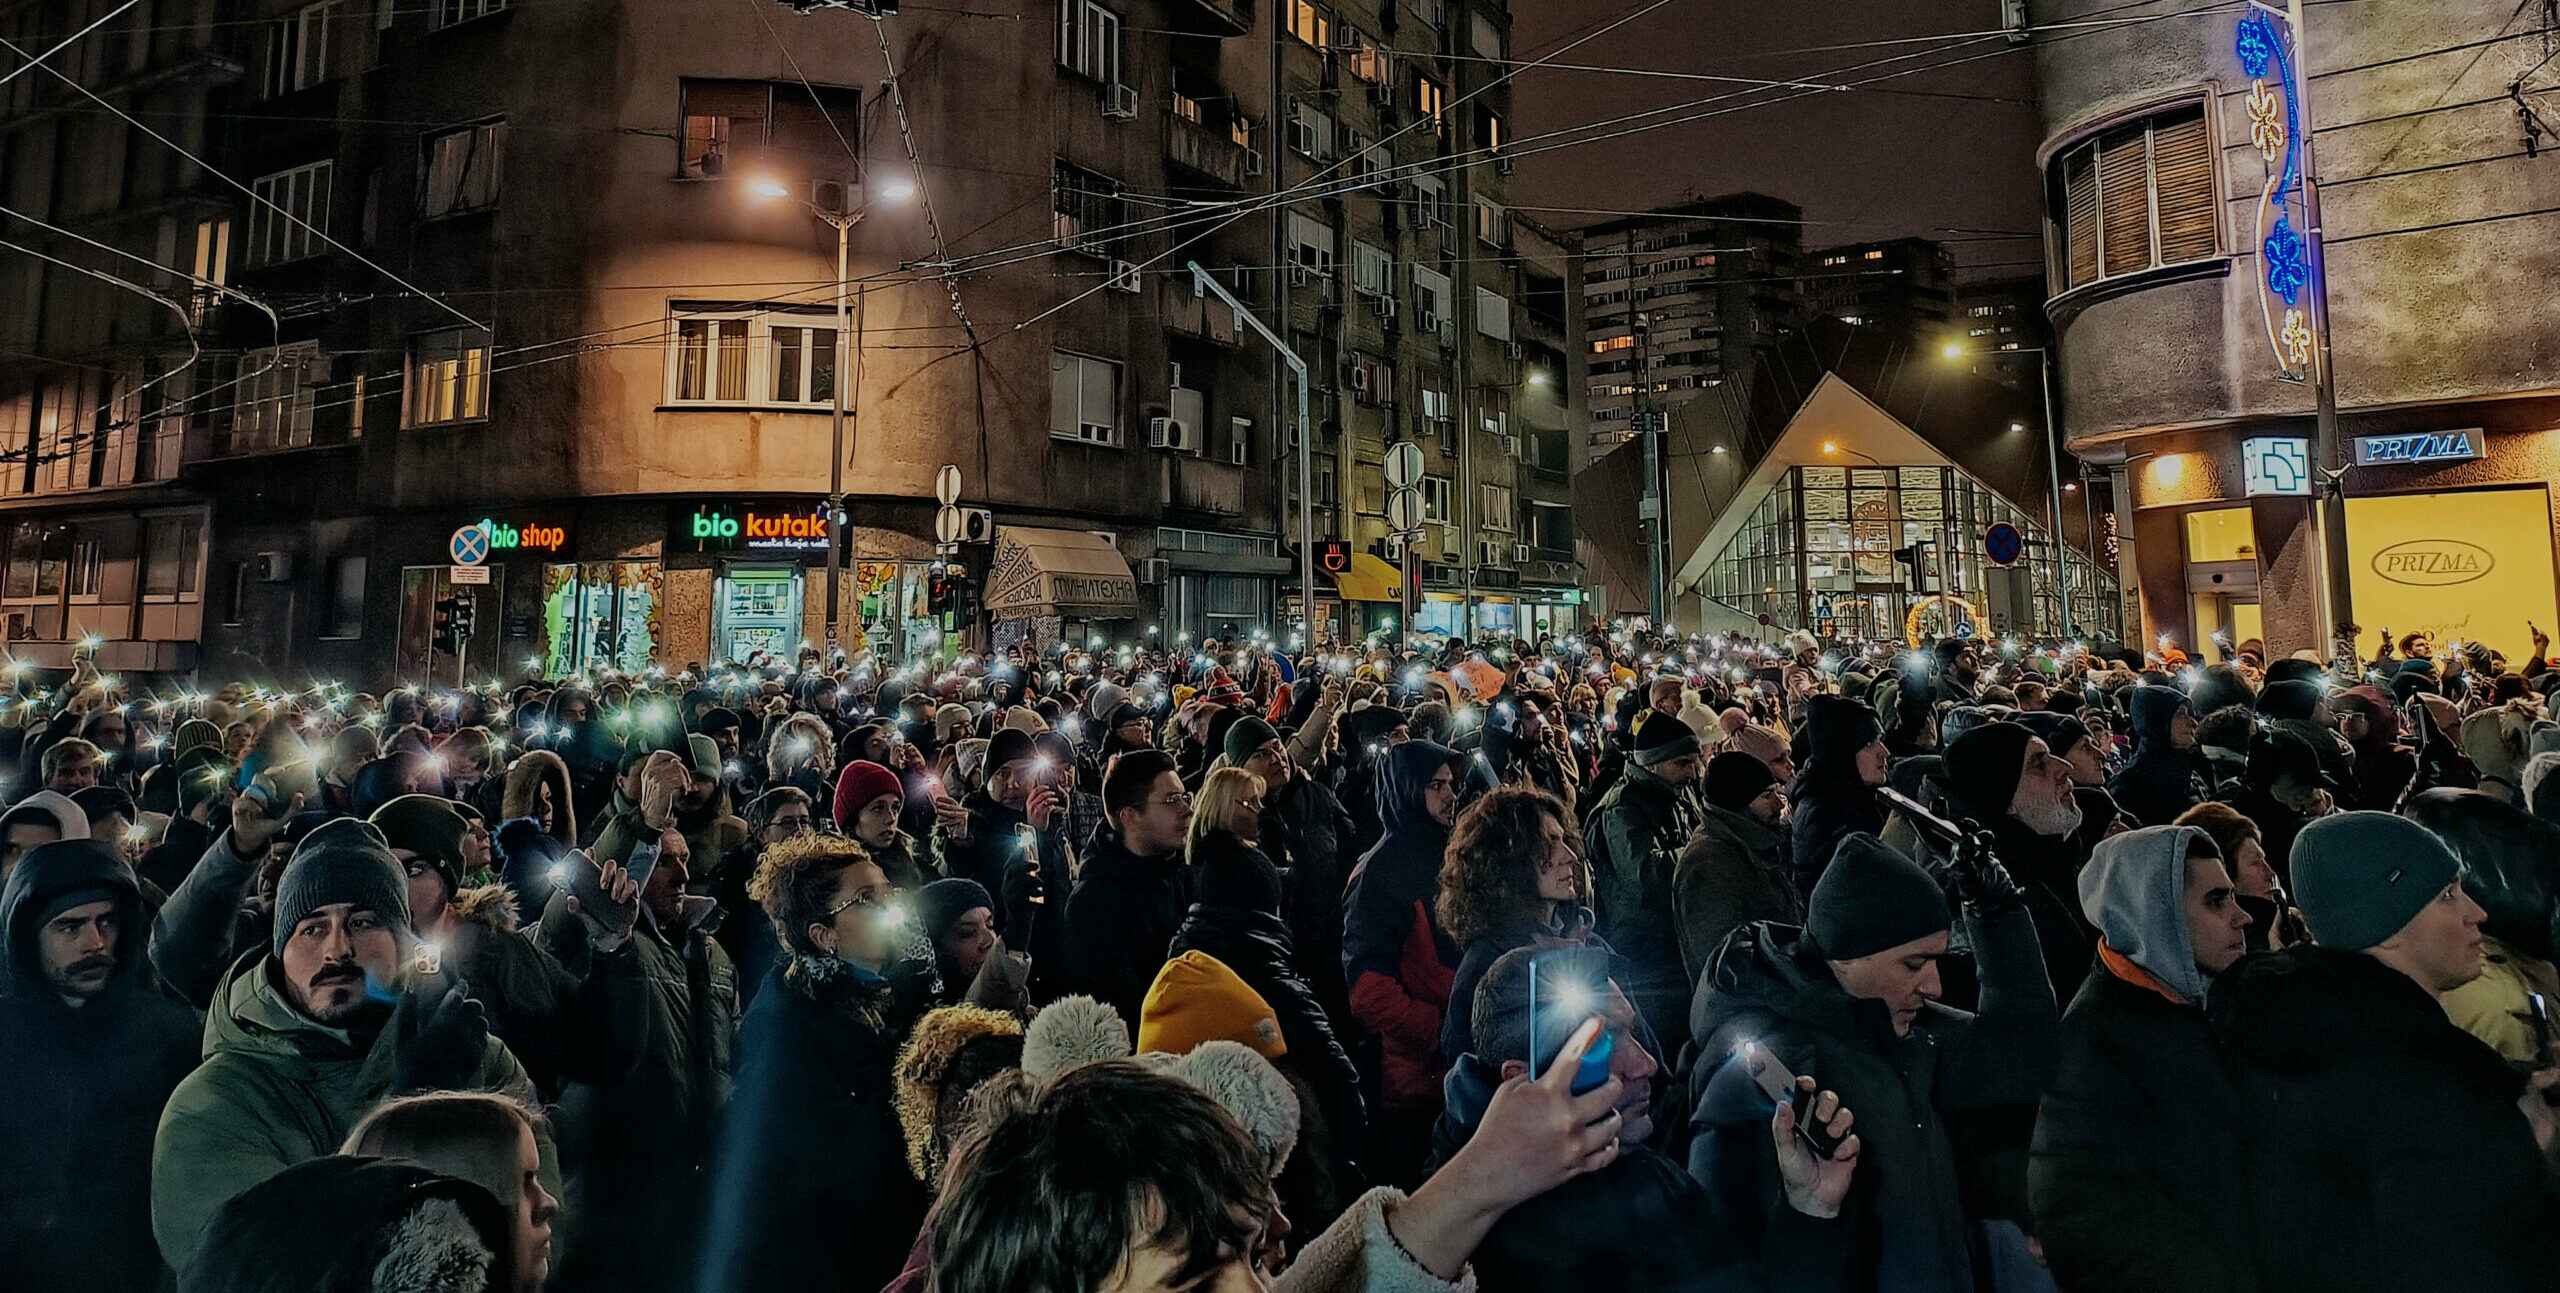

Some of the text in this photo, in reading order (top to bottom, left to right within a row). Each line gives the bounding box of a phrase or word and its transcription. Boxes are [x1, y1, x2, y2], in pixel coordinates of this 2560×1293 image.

[2365, 433, 2474, 461] PRIZMA
[490, 522, 565, 552] bio shop
[693, 512, 828, 537] bio kutak
[2384, 552, 2482, 574] PRIZMA
[1003, 578, 1043, 605] ВОДОВОД
